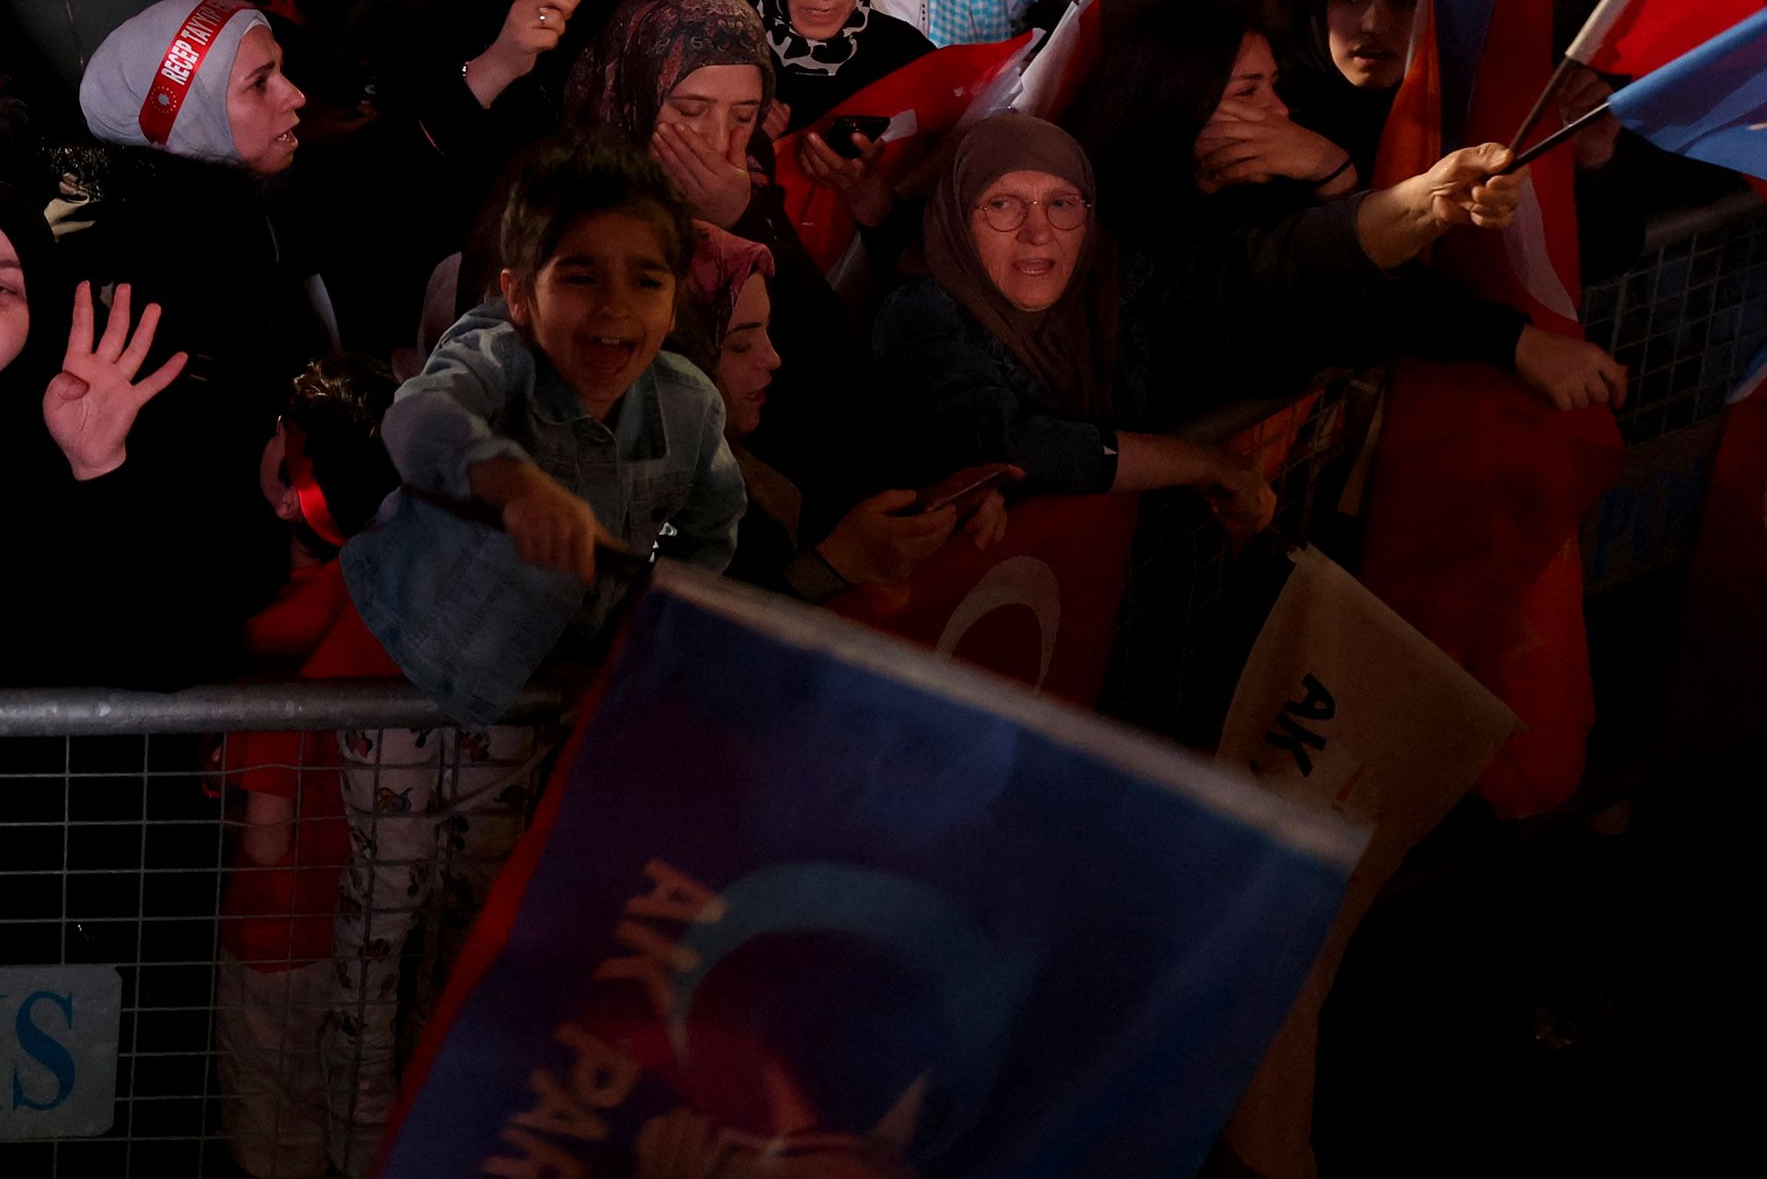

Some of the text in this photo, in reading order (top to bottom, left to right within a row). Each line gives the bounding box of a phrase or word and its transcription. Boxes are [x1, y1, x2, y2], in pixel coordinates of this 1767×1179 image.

[160, 38, 200, 86] RECEP
[1264, 672, 1335, 777] AK
[589, 858, 730, 1067] AK
